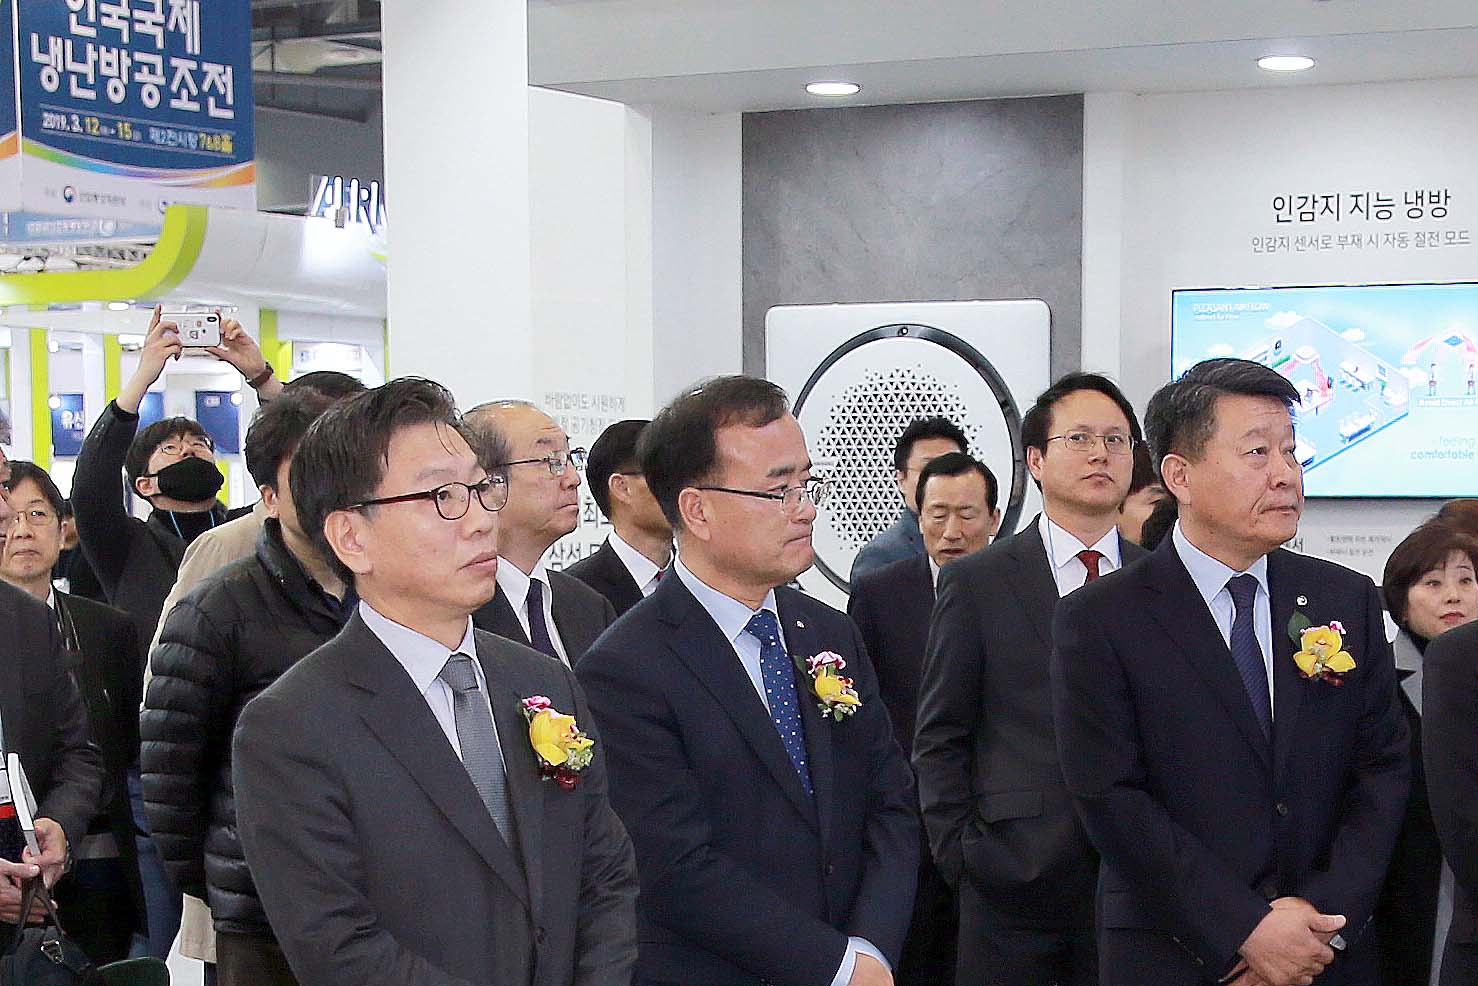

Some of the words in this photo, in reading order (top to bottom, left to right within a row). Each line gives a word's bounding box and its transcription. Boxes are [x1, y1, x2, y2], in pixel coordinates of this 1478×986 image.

[30, 32, 235, 119] 냉난방공조전
[1272, 193, 1341, 223] 인감지
[1349, 191, 1396, 221] 지능
[1404, 189, 1451, 219] 냉방
[1251, 235, 1290, 253] 인감지
[1294, 234, 1333, 252] 센서로
[1336, 233, 1364, 250] 부재
[1366, 232, 1380, 249] 시
[1383, 232, 1411, 250] 자동
[1414, 231, 1441, 248] 절전
[1444, 230, 1472, 246] 모드
